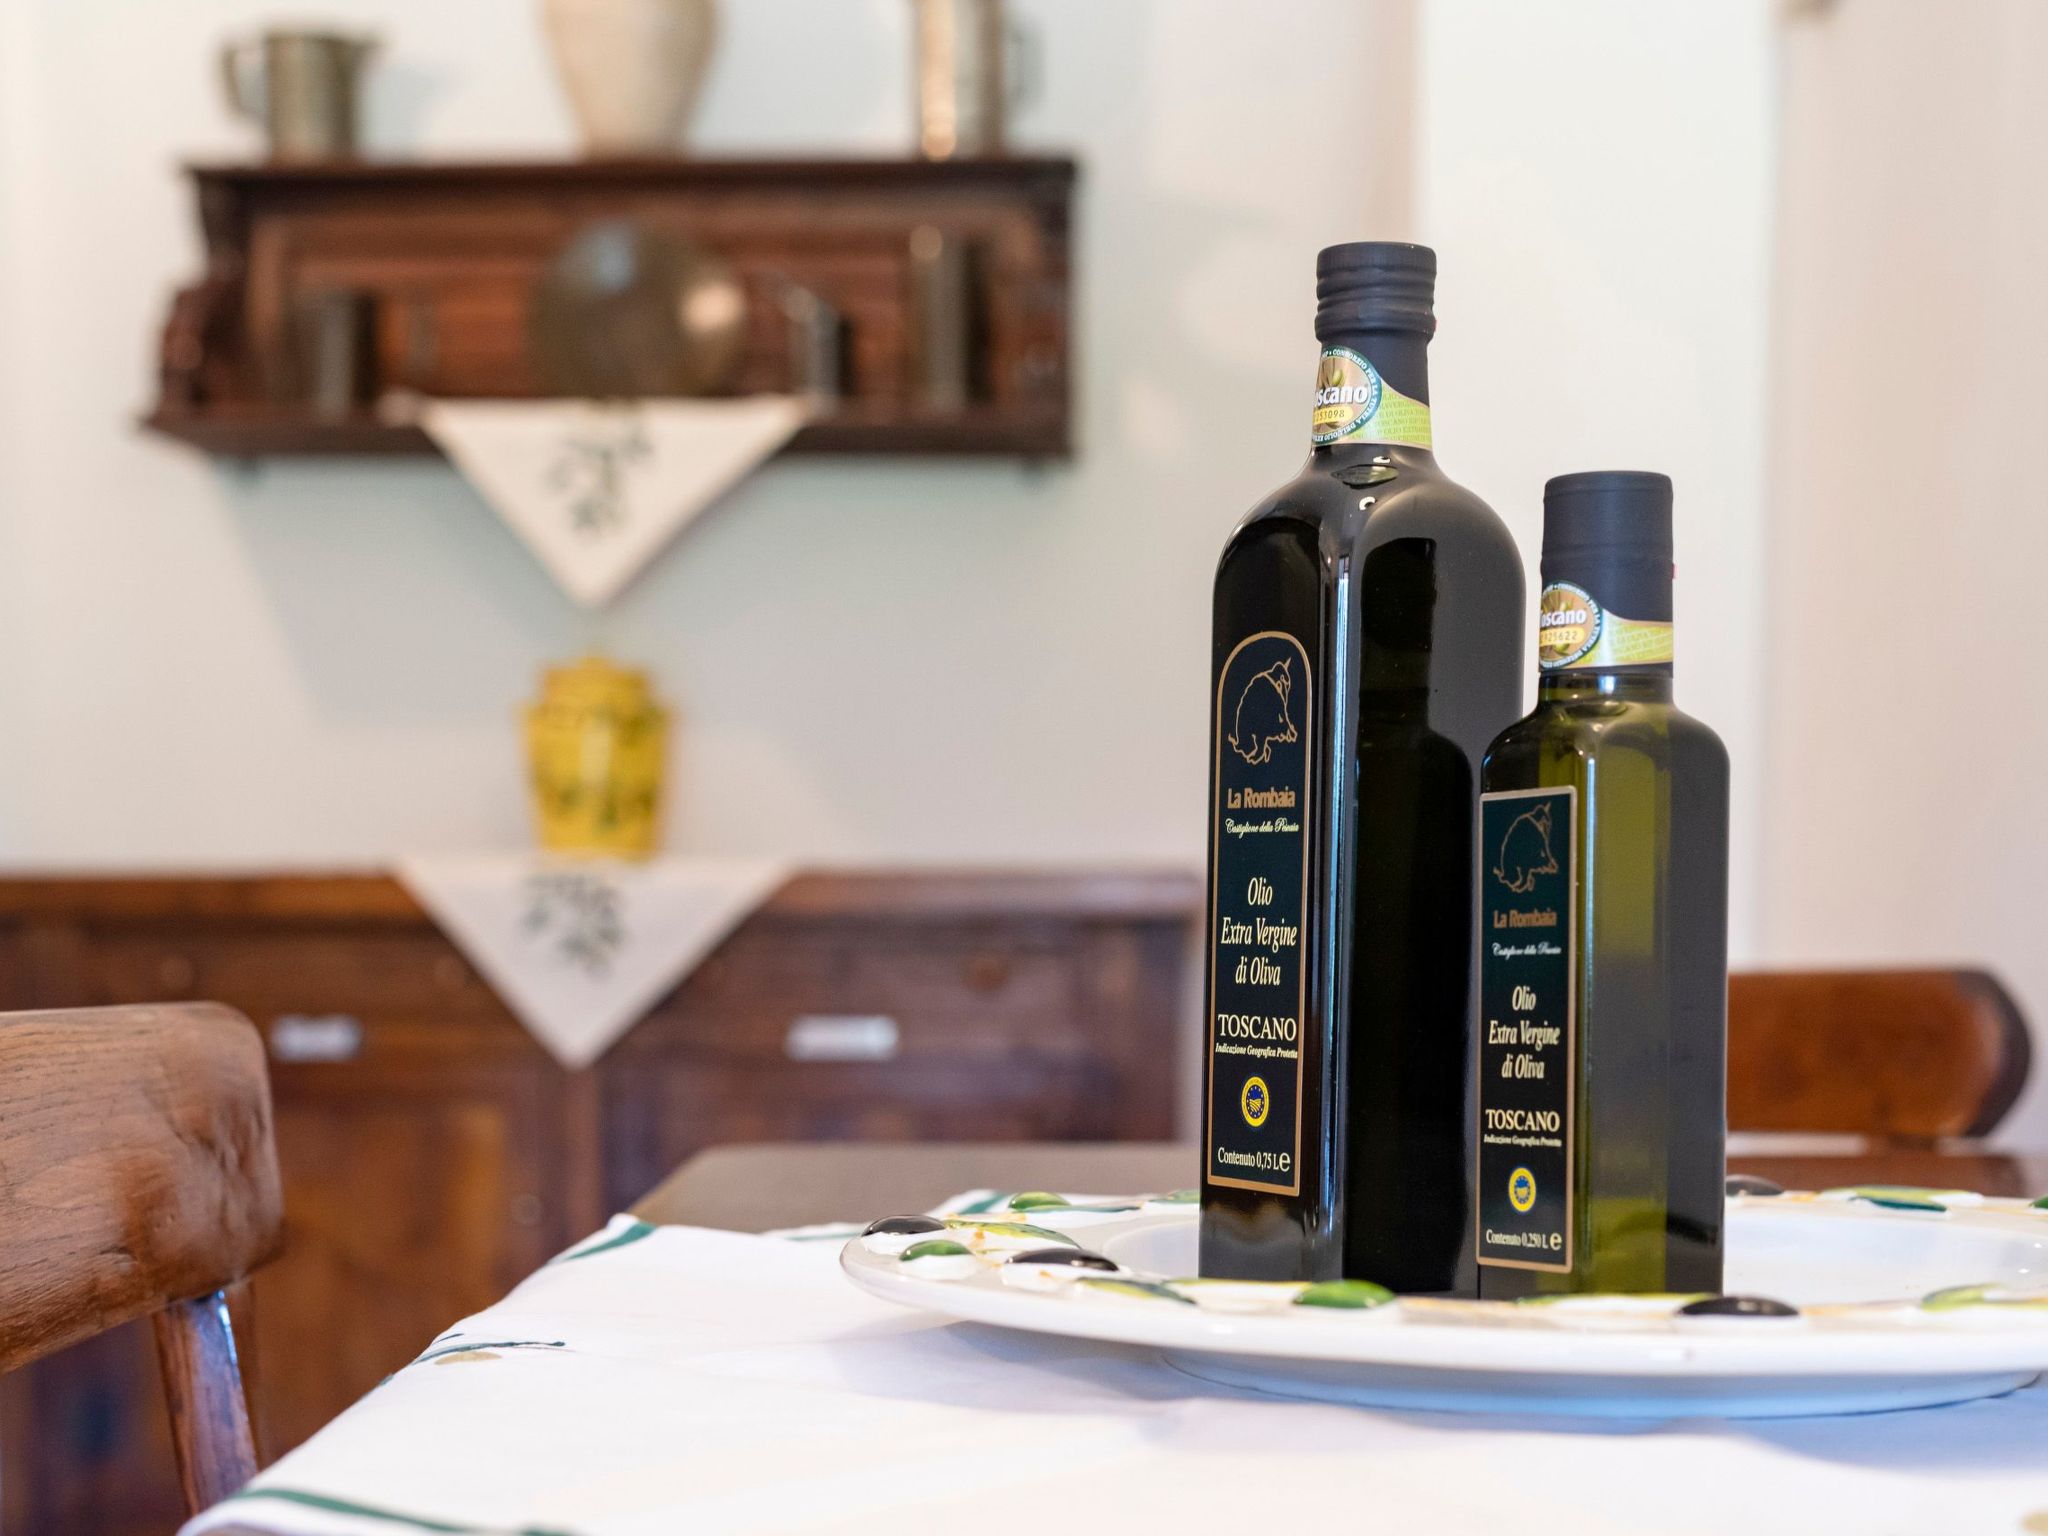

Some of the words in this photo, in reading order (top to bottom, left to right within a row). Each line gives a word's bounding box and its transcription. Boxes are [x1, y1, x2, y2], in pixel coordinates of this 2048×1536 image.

[1227, 788, 1241, 809] La
[1244, 785, 1296, 808] Rombaia
[1225, 818, 1259, 839] Castiglione
[1259, 821, 1273, 833] della
[1247, 876, 1273, 906] Olio
[1493, 910, 1507, 928] La
[1509, 907, 1557, 928] Rombaia
[1221, 916, 1253, 945] Extra
[1256, 917, 1298, 953] Vergine
[1235, 955, 1248, 984] di
[1250, 956, 1281, 986] Oliva
[1512, 985, 1537, 1011] Olio
[1217, 1014, 1297, 1041] TOSCANO
[1488, 1020, 1518, 1044] Extra
[1520, 1020, 1561, 1052] Vergine
[1215, 1042, 1246, 1055] Indicazione
[1247, 1044, 1276, 1059] Geografica
[1501, 1053, 1513, 1078] di
[1515, 1053, 1545, 1079] Oliva
[1485, 1109, 1560, 1132] TOSCANO
[1217, 1146, 1255, 1167] Contenuto
[1256, 1151, 1272, 1171] 0,75
[1486, 1228, 1522, 1246] Contenuto
